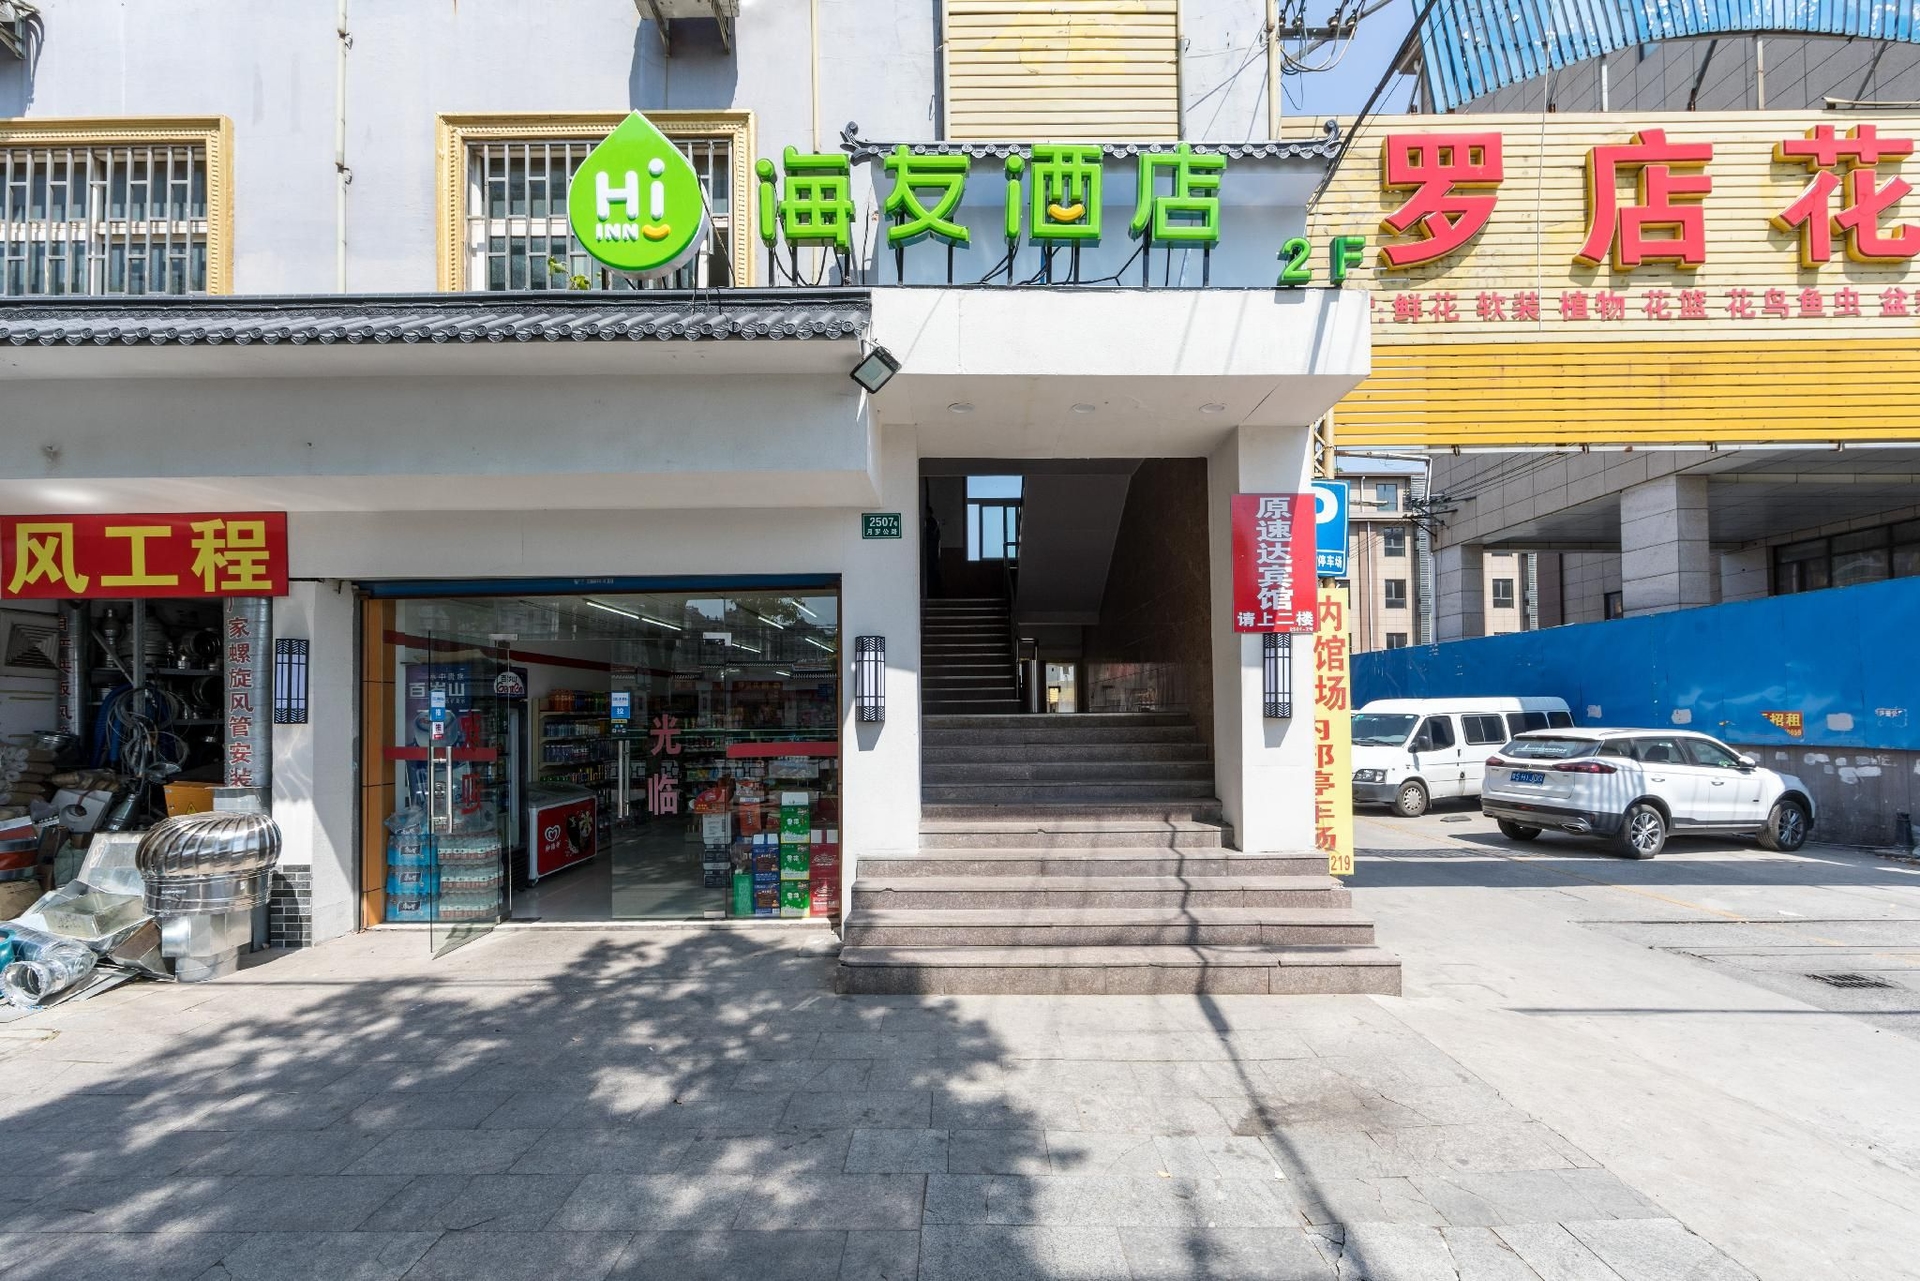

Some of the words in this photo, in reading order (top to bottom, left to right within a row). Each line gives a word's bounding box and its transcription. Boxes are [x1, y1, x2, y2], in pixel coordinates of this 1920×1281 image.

[596, 158, 665, 221] Hi
[1380, 124, 1920, 271] 罗店花
[596, 223, 639, 243] INN
[1392, 292, 1460, 323] 鲜花
[1475, 291, 1540, 323] 软装
[1558, 290, 1627, 322] 植物
[1641, 289, 1709, 321] 花篮
[1724, 286, 1862, 320] 花鸟鱼虫
[1878, 286, 1920, 317] 盆
[7, 518, 273, 594] 风工程
[1256, 497, 1294, 611] 原速达宾馆
[1237, 611, 1314, 627] 请上二楼
[1762, 713, 1800, 726] 招租
[648, 714, 681, 815] 光临
